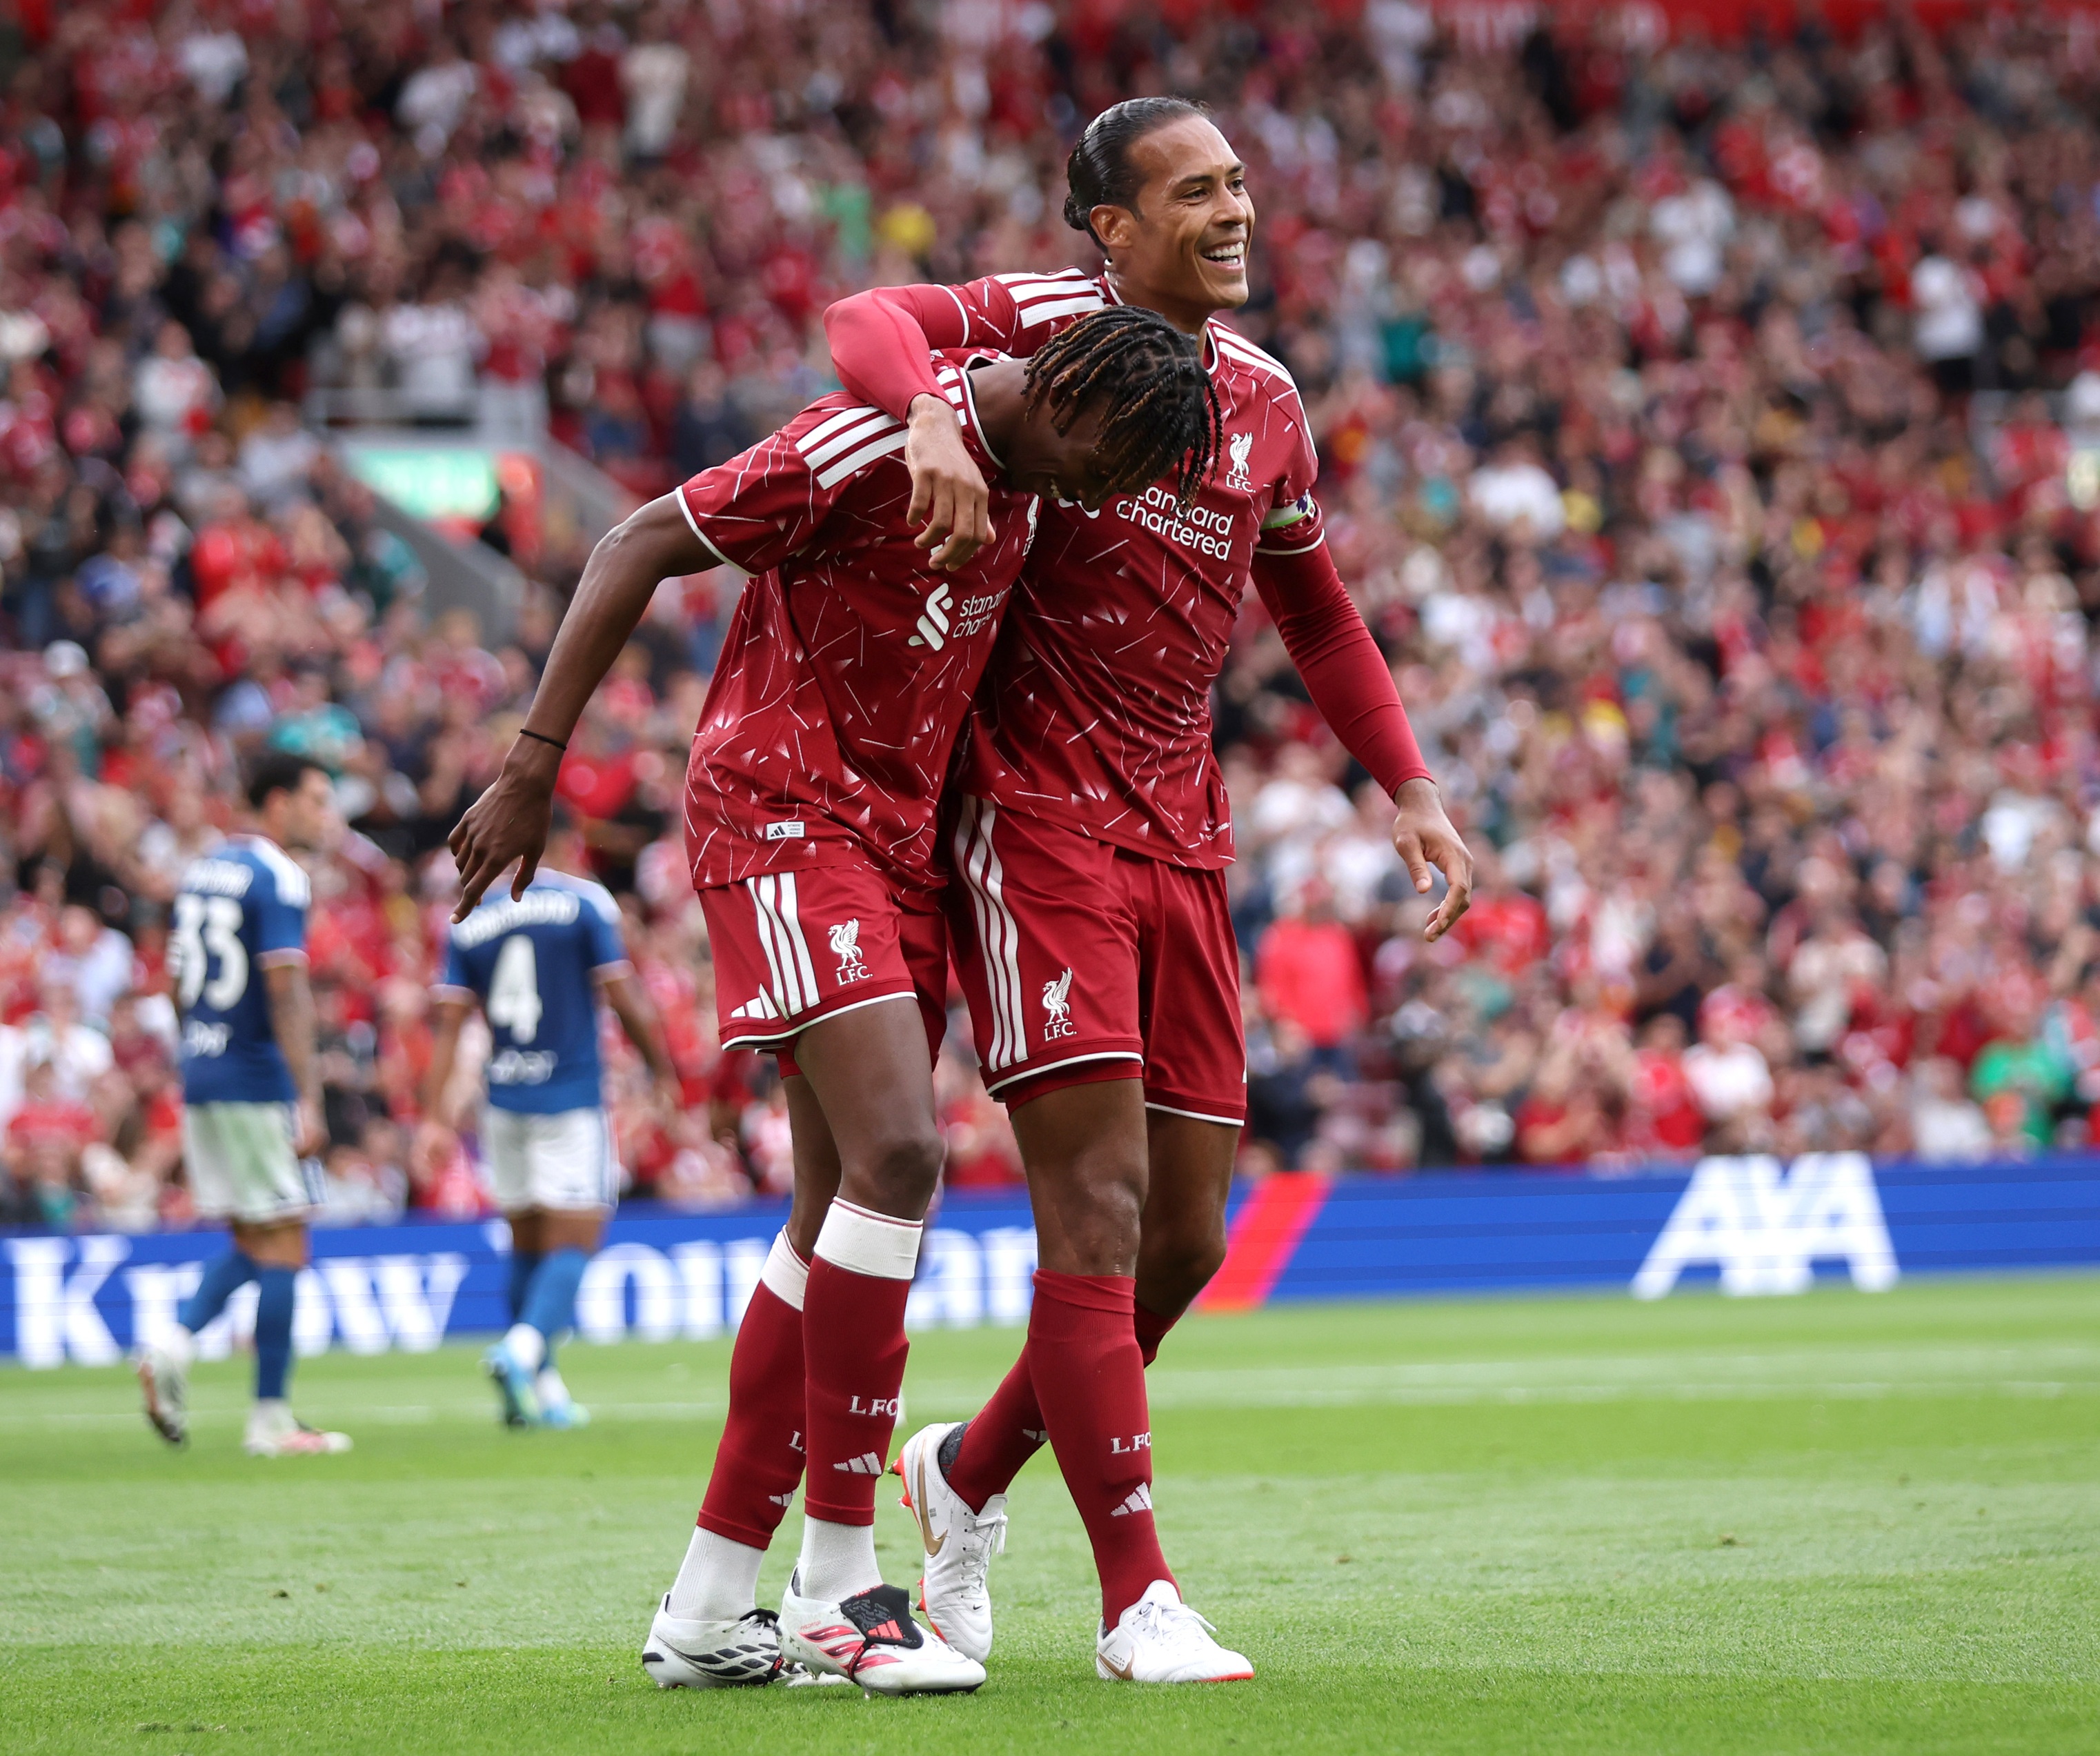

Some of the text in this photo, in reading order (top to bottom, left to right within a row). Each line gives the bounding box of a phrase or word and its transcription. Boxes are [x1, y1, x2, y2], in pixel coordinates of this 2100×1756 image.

[1116, 500, 1233, 561] chartered
[486, 932, 544, 1045] 4
[835, 966, 873, 986] L.F.C.
[1044, 1021, 1078, 1042] L.F.C.
[1631, 1150, 1902, 1302] AXA
